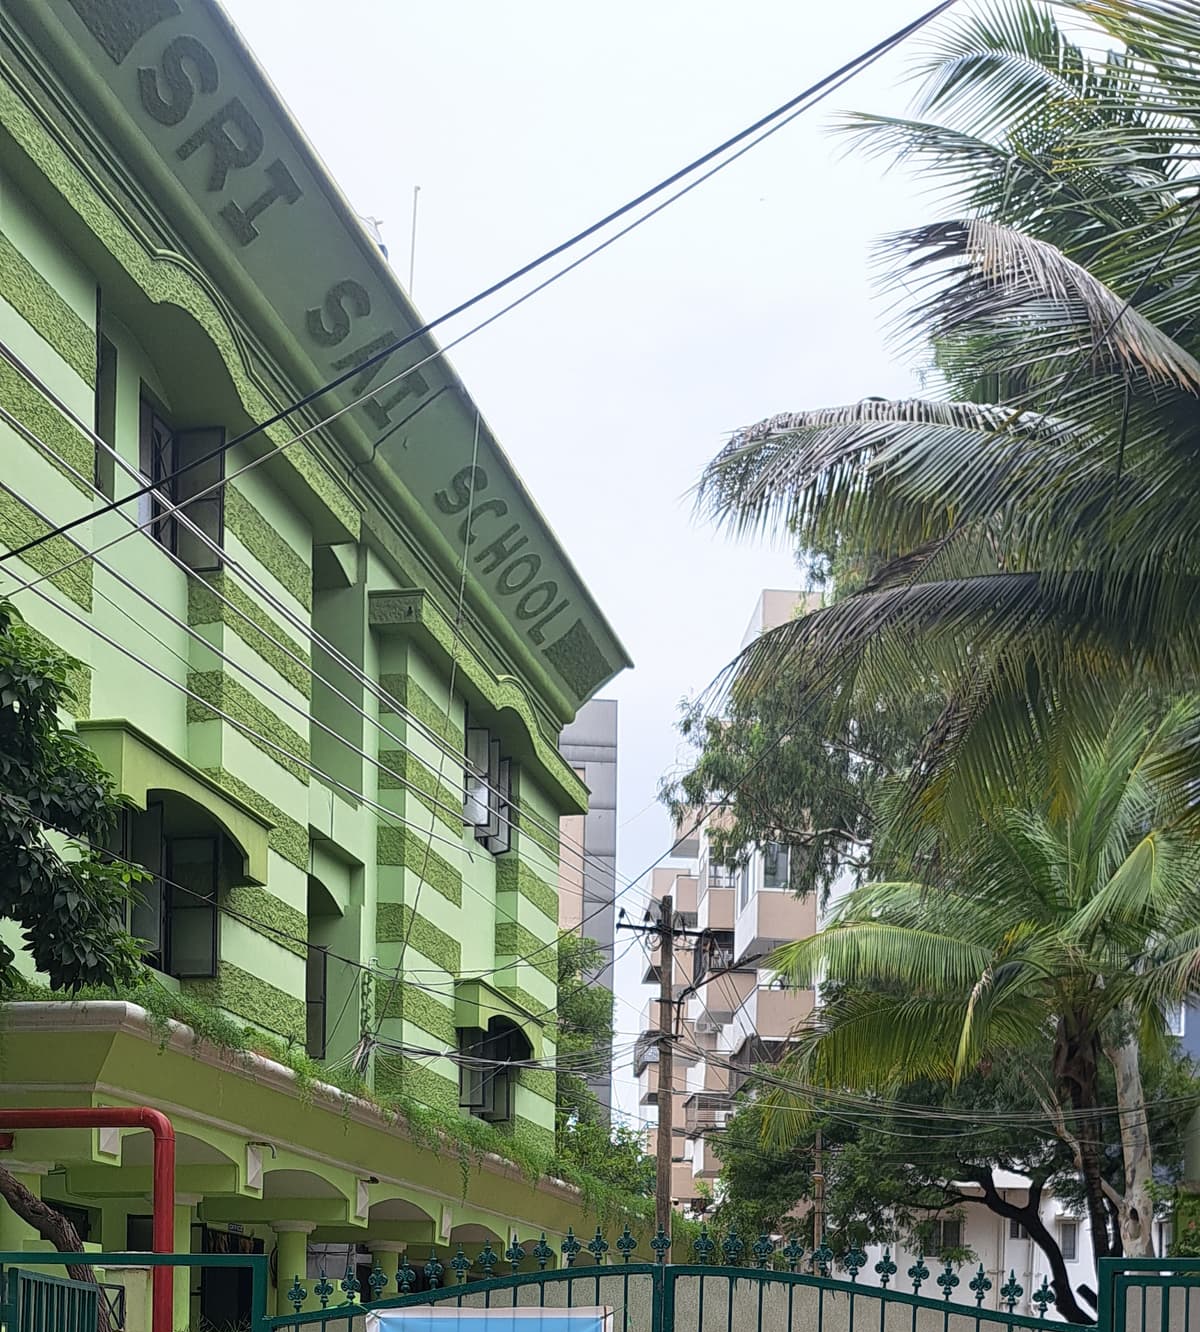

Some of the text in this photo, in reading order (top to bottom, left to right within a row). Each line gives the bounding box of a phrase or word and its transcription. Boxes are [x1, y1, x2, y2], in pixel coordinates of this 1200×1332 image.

[137, 34, 570, 646] SRI SAI SCHOOL
